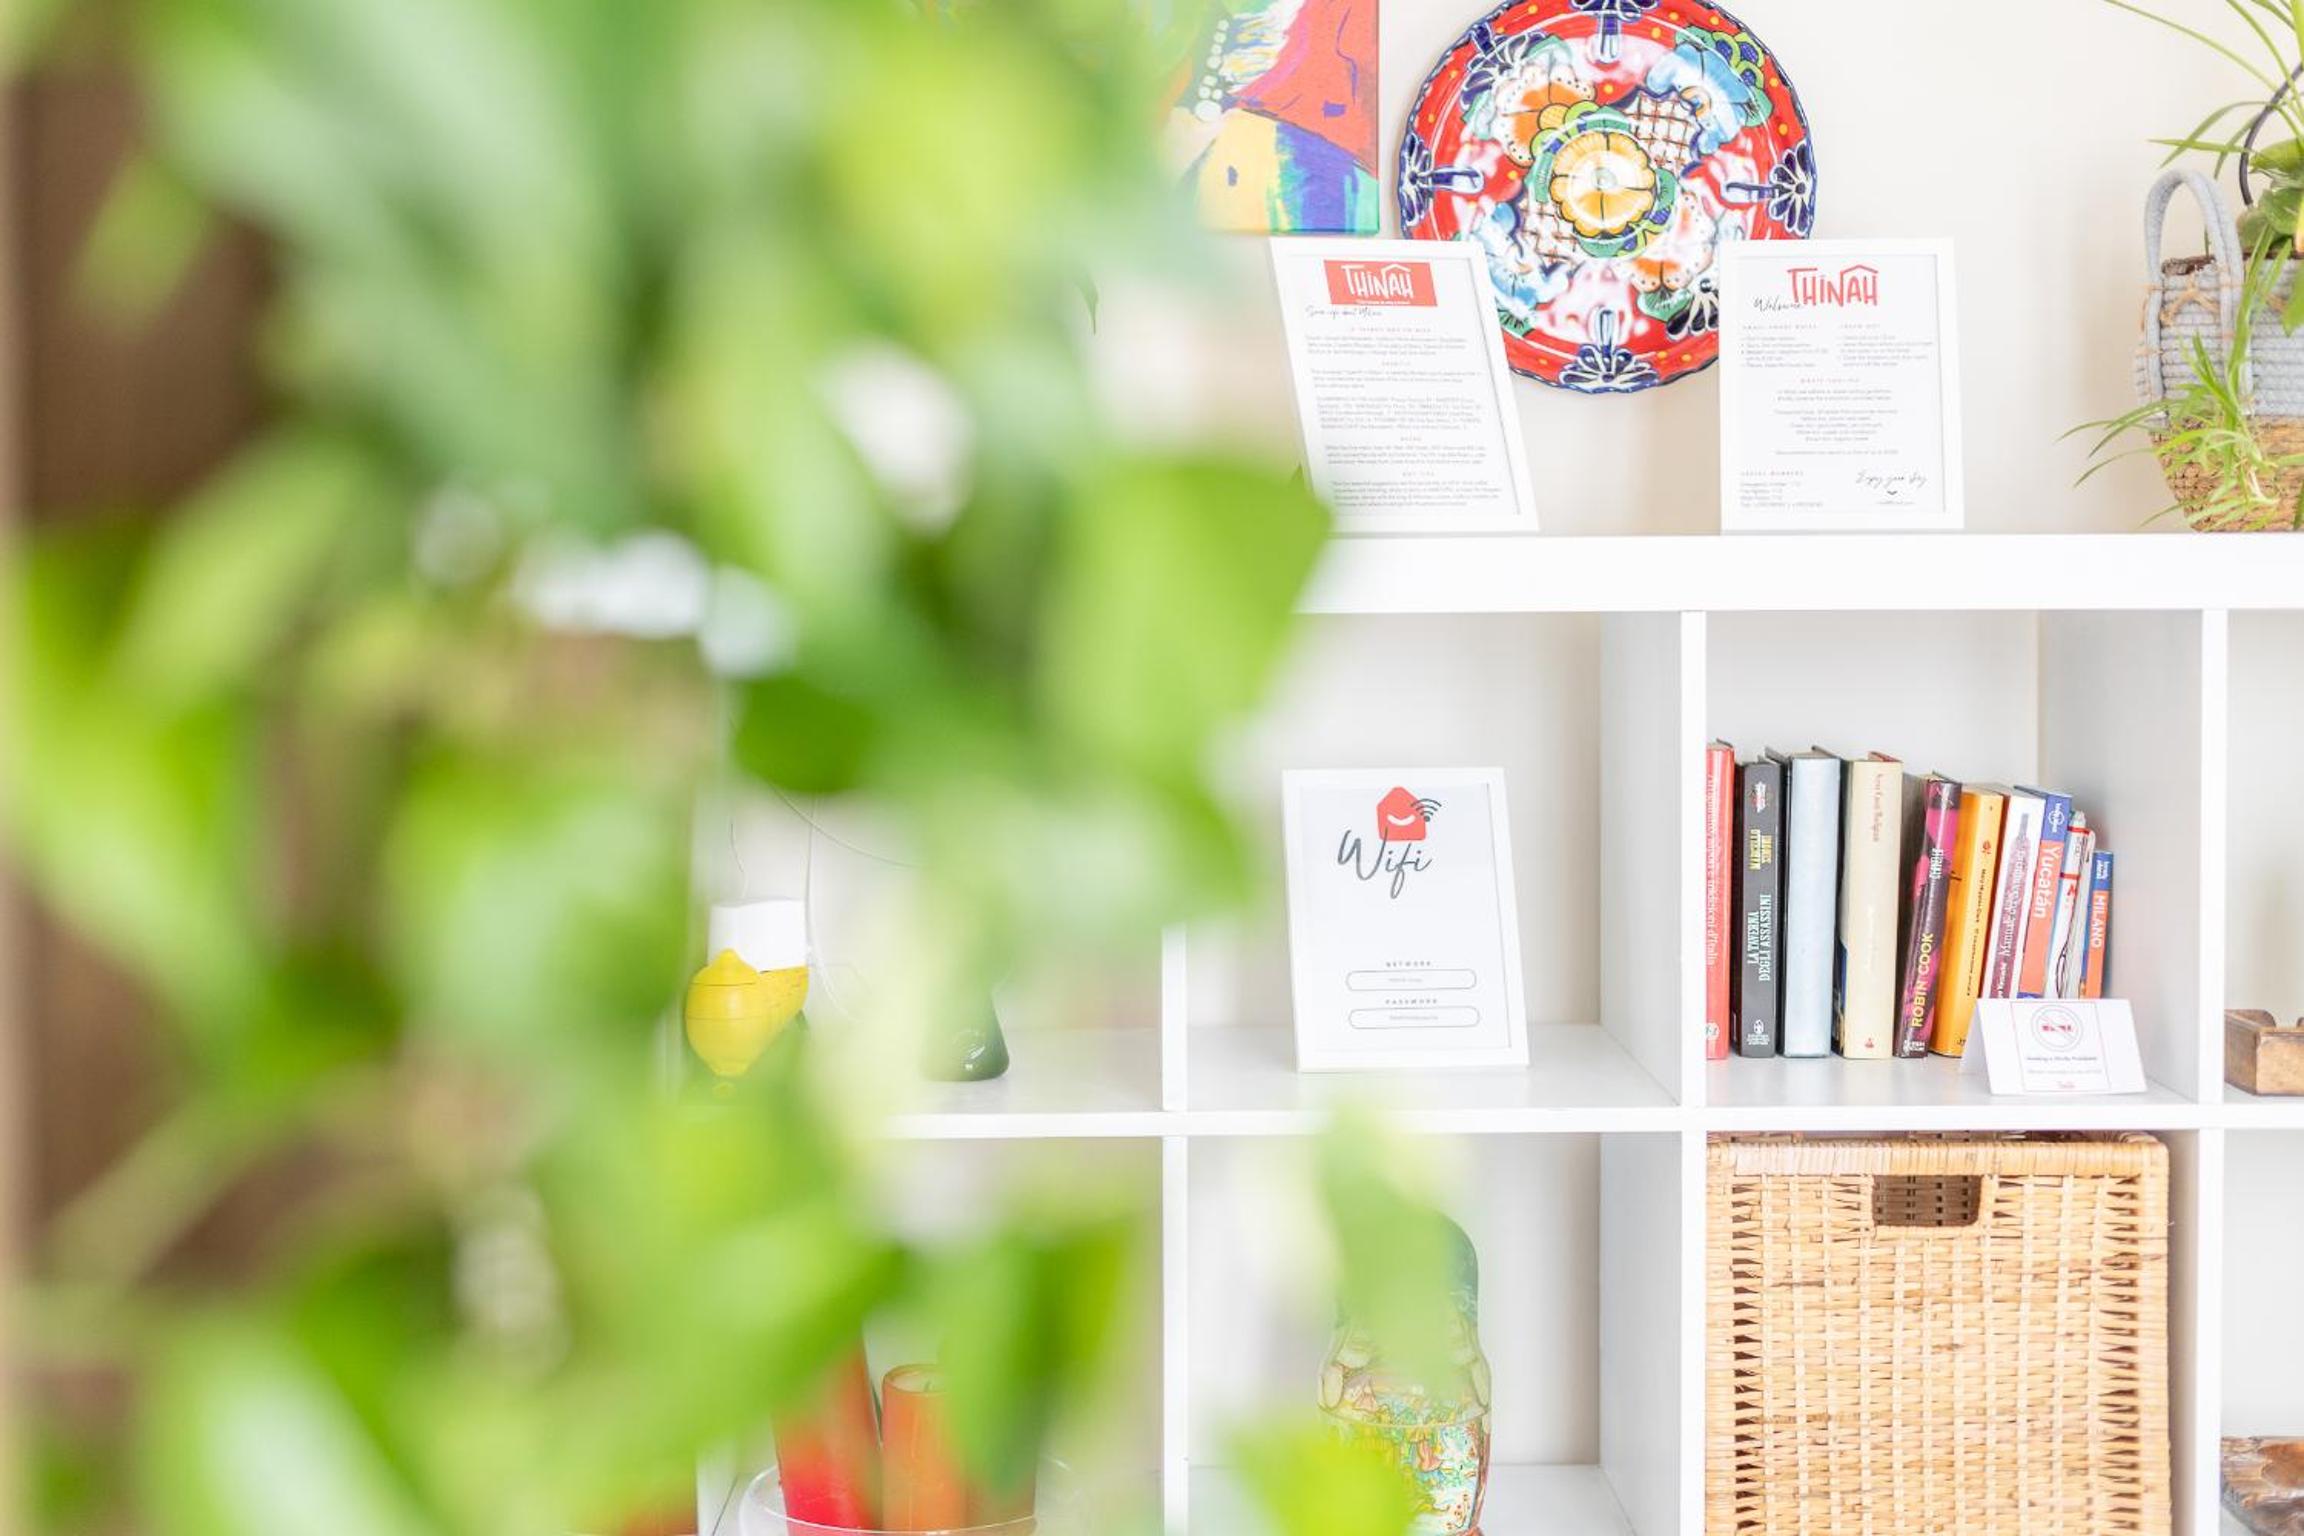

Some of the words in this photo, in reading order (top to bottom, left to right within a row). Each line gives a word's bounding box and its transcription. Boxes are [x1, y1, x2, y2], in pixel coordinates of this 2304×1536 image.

[1337, 827, 1433, 900] Wifi
[2034, 845, 2062, 919] Yucatán
[1747, 911, 1759, 950] TAVERNA
[1759, 893, 1773, 947] ASSASSINI
[2092, 893, 2108, 949] MILANO
[1758, 950, 1771, 982] DEGLI
[1917, 932, 1934, 975] COOK
[1911, 979, 1928, 1028] ROBIN
